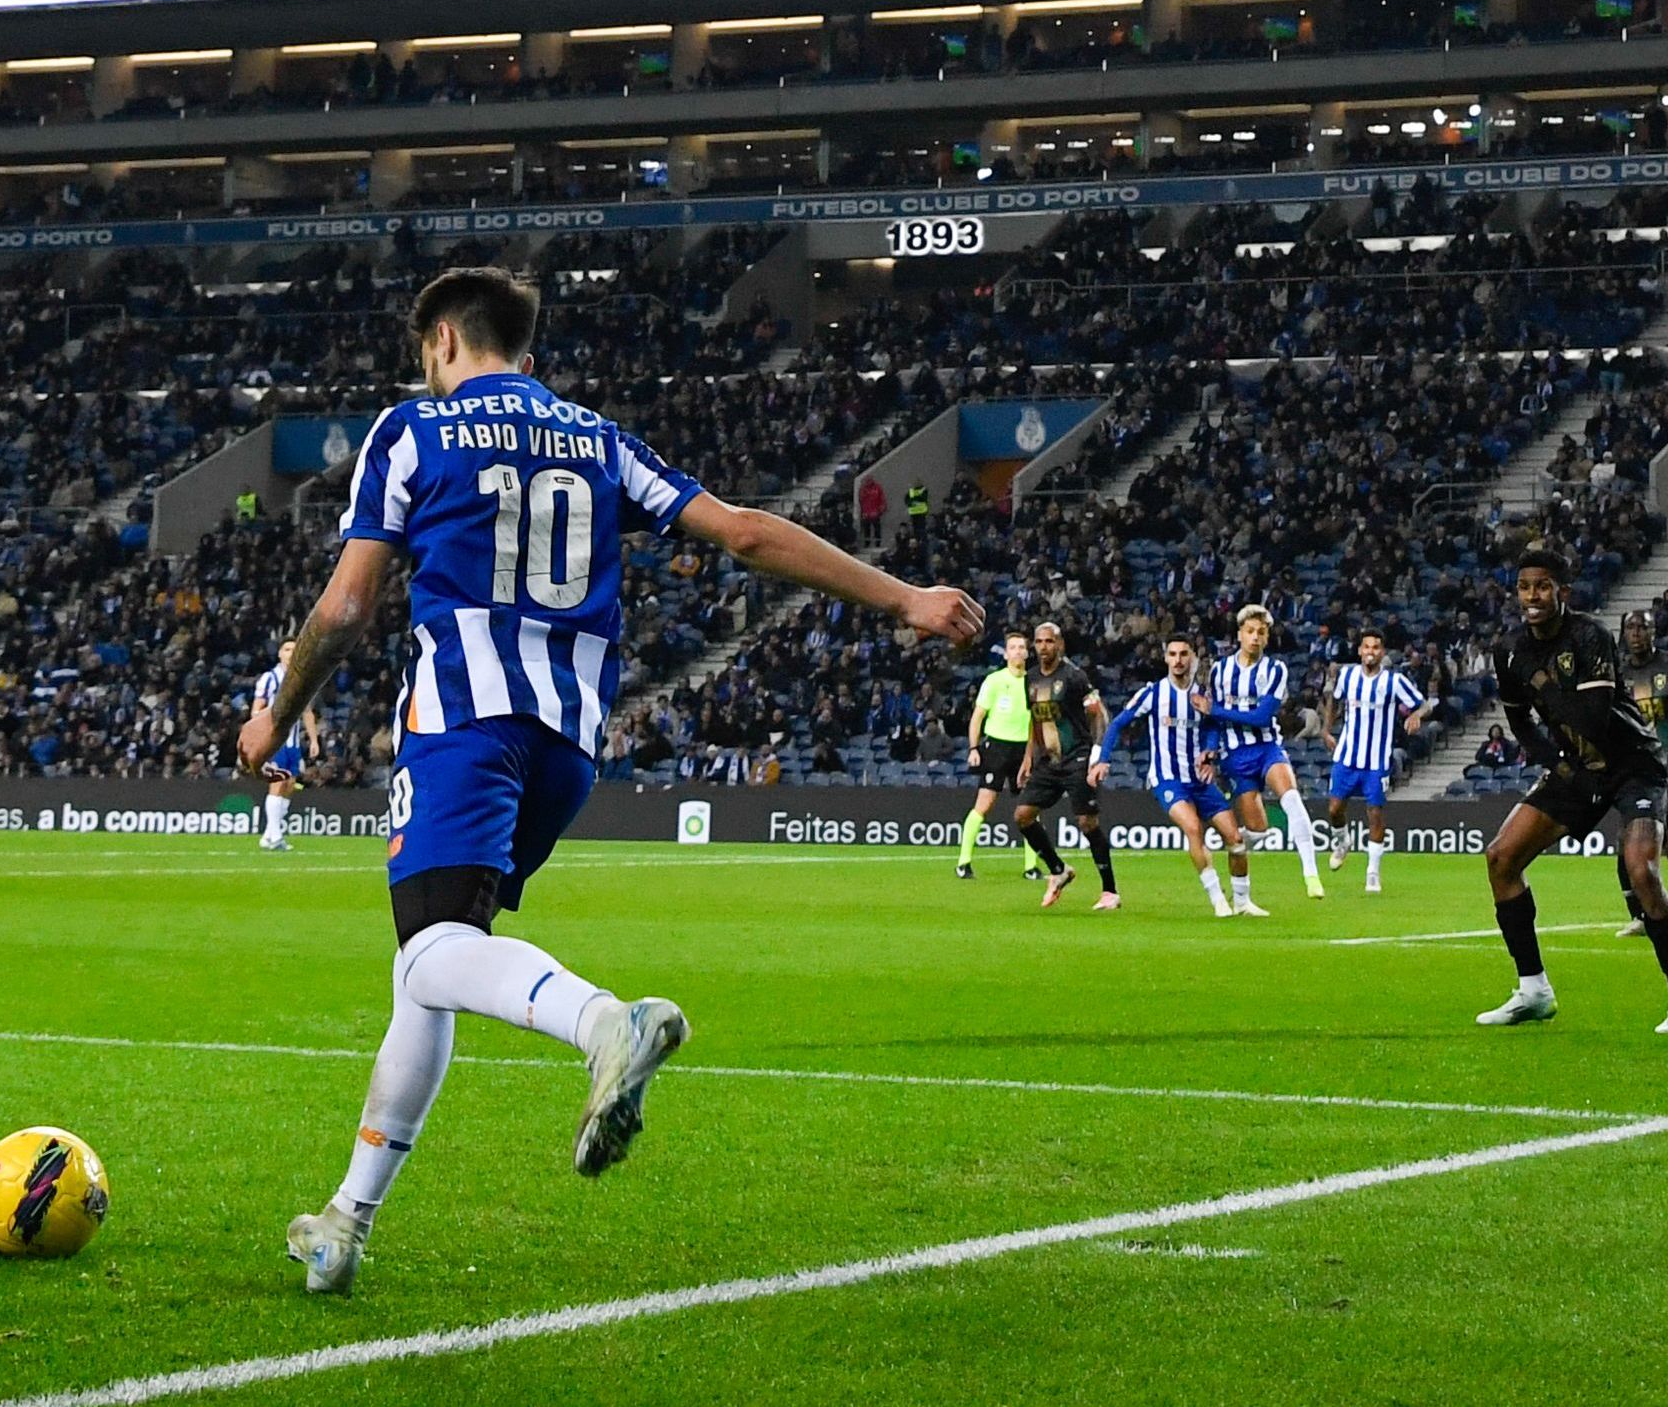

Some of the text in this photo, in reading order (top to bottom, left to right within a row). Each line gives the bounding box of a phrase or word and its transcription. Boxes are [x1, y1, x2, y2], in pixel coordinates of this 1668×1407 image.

[1463, 167, 1561, 186] CLUBE
[1570, 164, 1612, 181] DO
[772, 186, 1140, 217] FUTEBOL CLUBE DO PORTO
[33, 228, 113, 245] PORTO
[268, 210, 605, 237] FUTEBOL CUBE DO PORTO
[885, 218, 984, 256] 1893
[415, 394, 603, 428] SUPER BOC
[439, 420, 607, 465] FÁBIO VIEIRA
[477, 463, 593, 610] 10
[388, 765, 414, 829] 0
[37, 809, 54, 831] a
[62, 803, 98, 833] bp
[104, 805, 261, 835] compensa!
[350, 813, 392, 837] ma
[769, 811, 856, 843] Feitas
[865, 820, 900, 844] as
[908, 818, 1017, 849] conas,
[1406, 821, 1484, 854] mais
